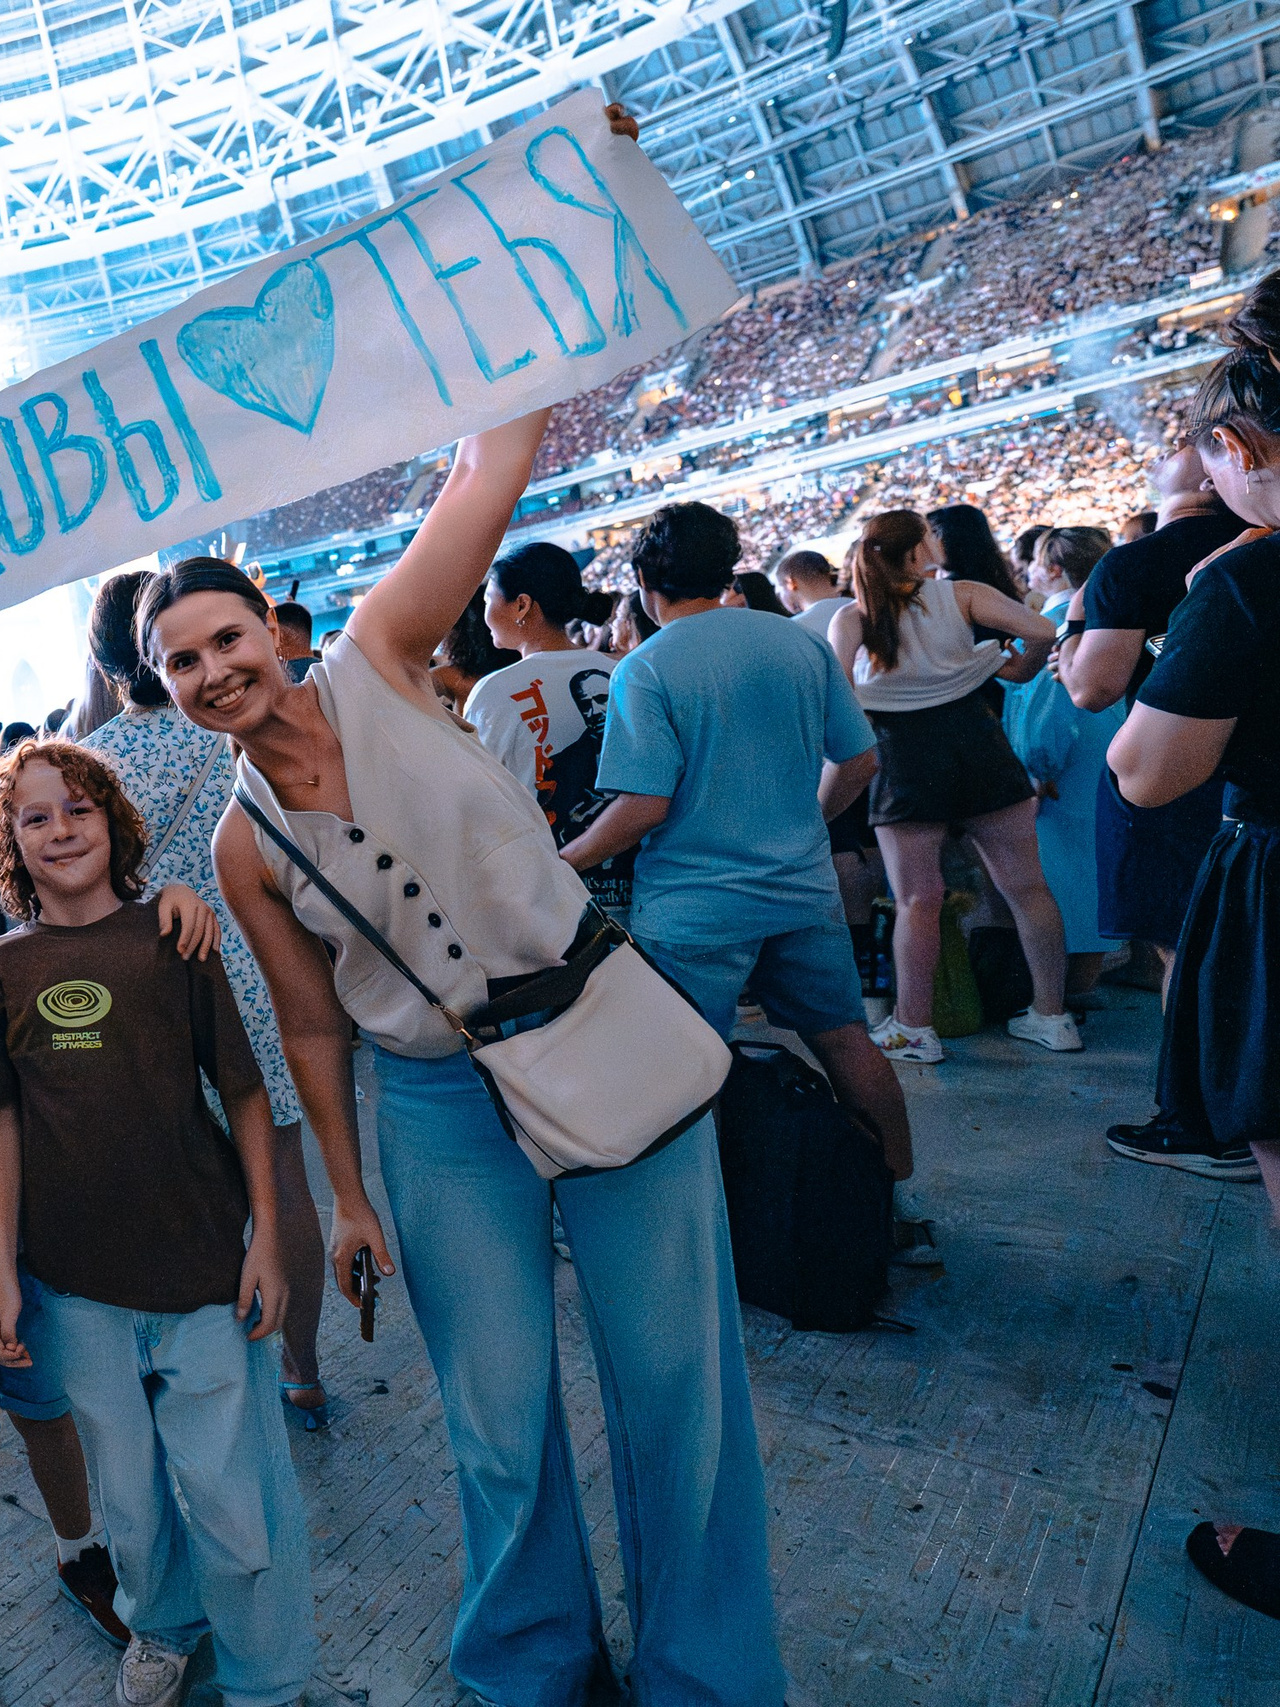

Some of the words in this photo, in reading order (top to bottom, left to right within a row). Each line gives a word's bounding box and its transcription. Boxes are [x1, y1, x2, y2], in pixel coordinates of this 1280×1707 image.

[312, 125, 688, 406] ТЕБЯ
[51, 1031, 101, 1041] ABSTRACT
[52, 1040, 103, 1050] CANVASES
